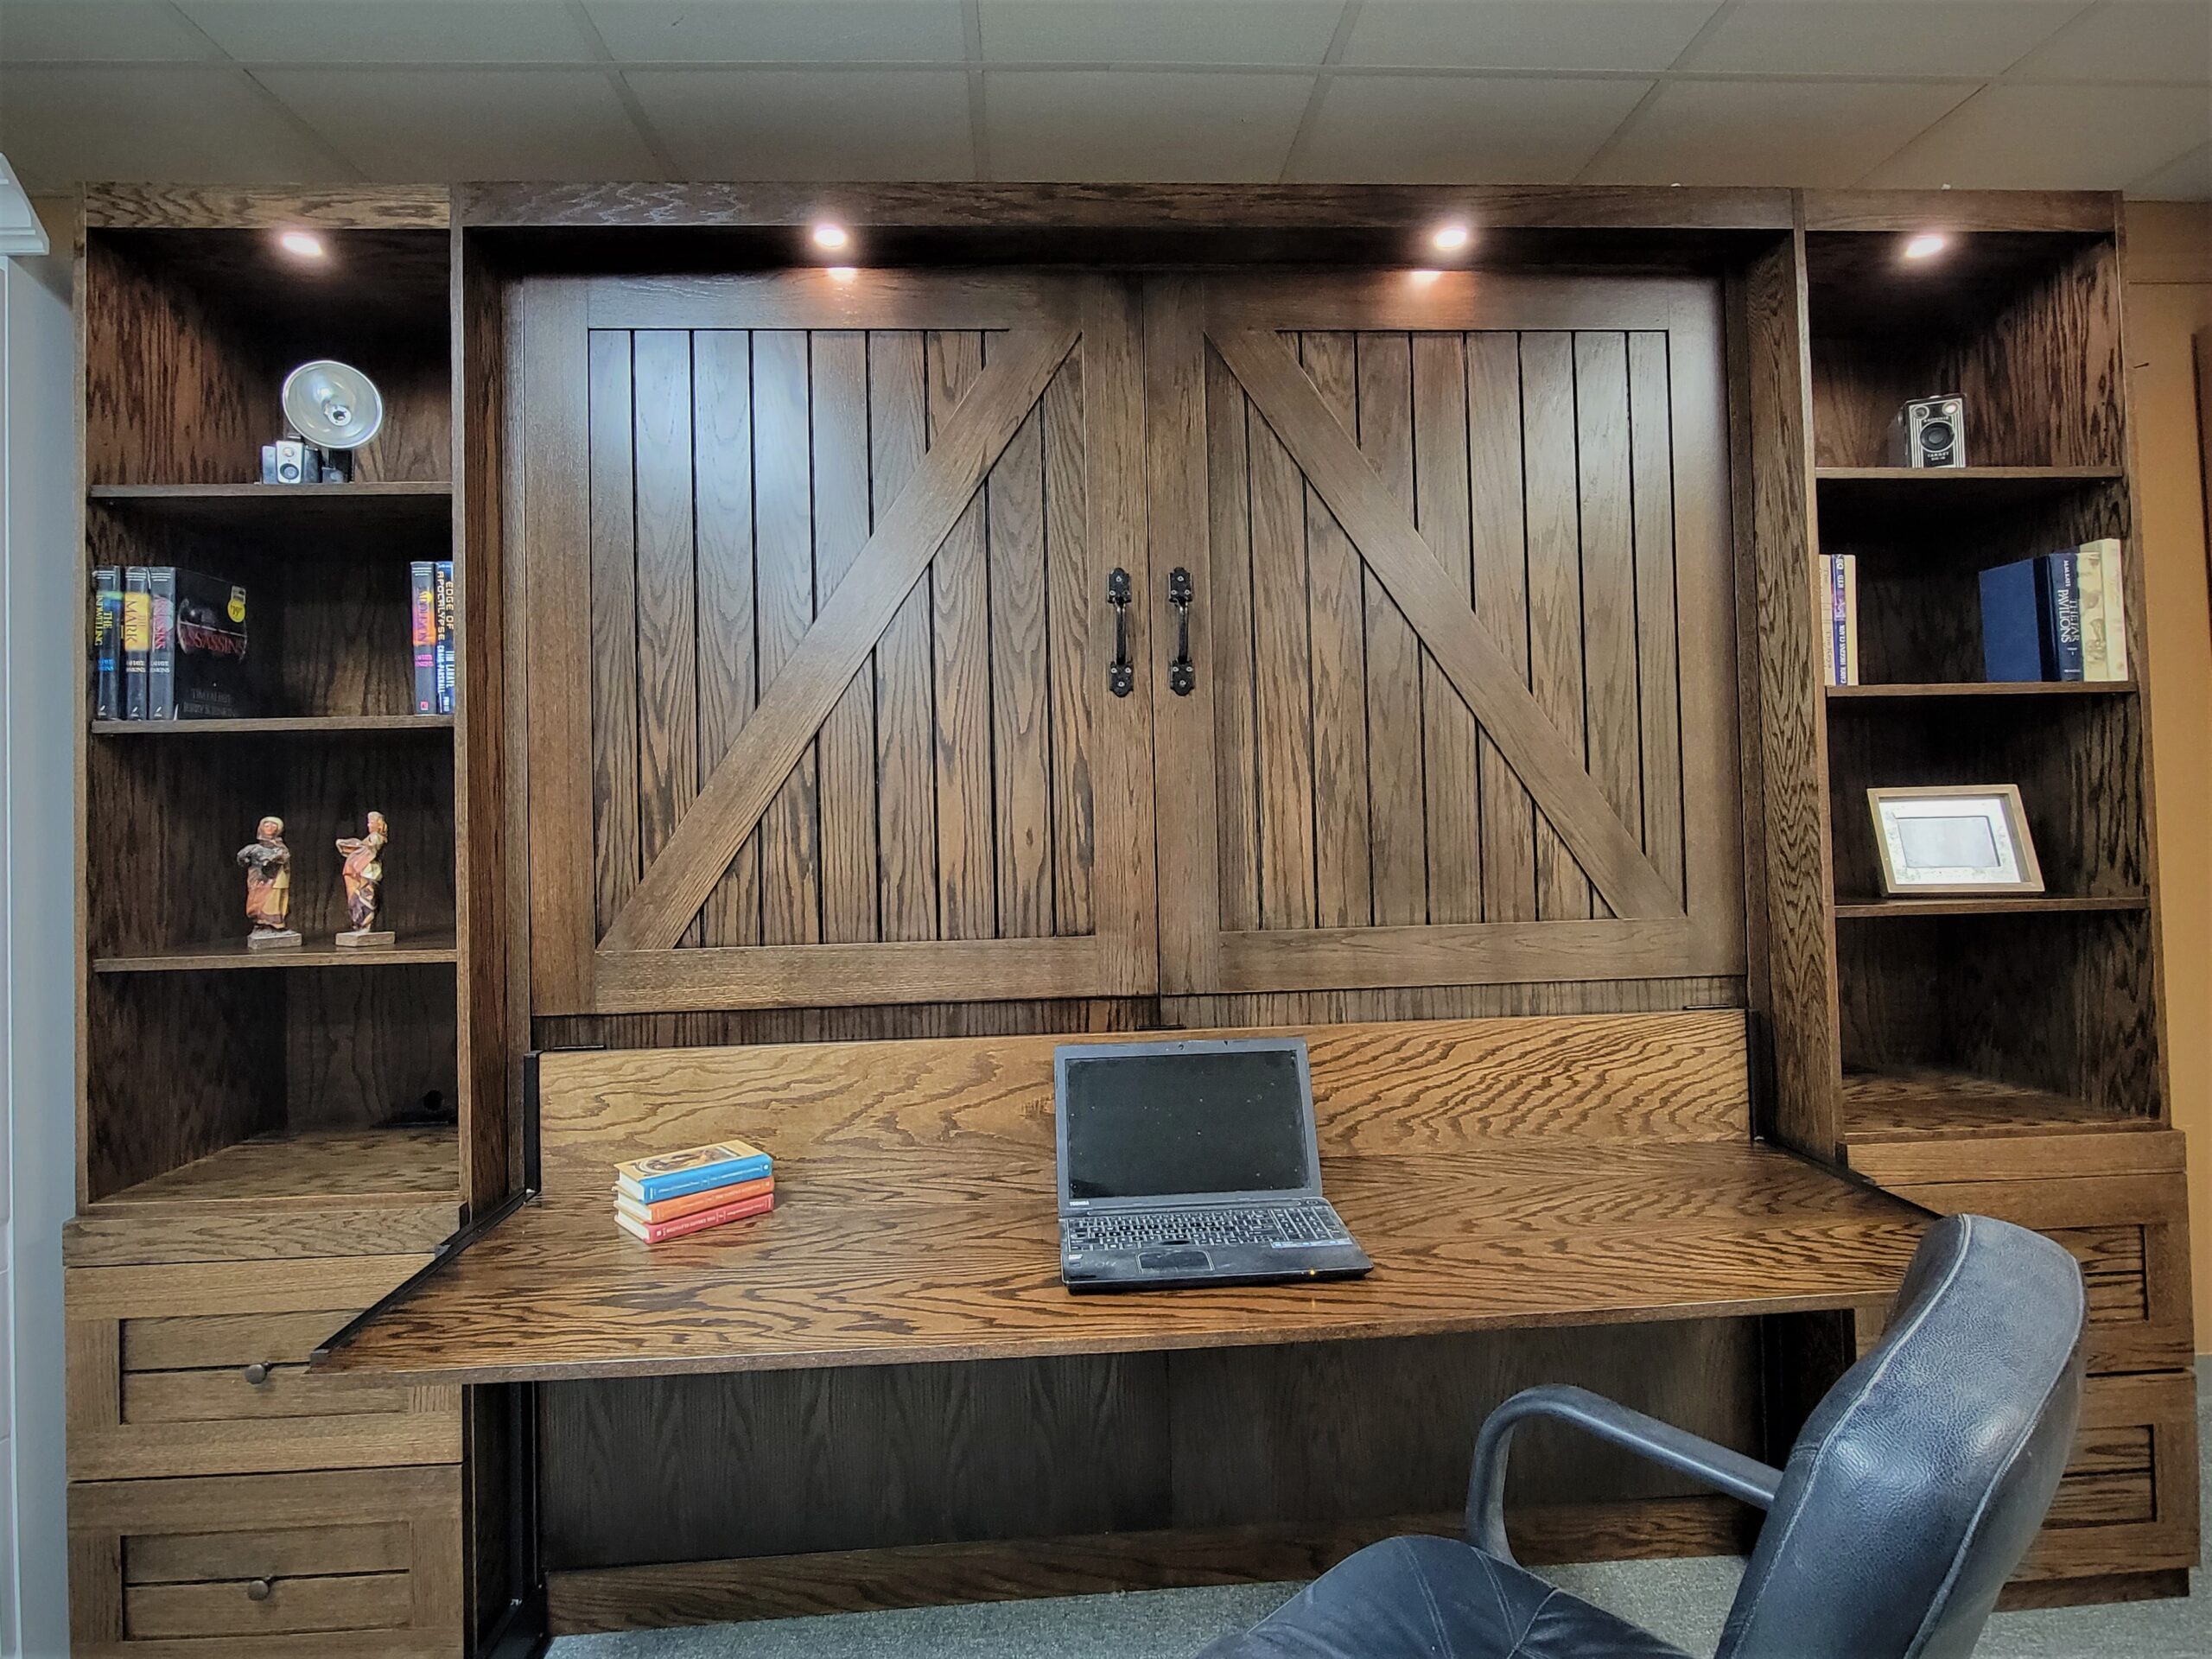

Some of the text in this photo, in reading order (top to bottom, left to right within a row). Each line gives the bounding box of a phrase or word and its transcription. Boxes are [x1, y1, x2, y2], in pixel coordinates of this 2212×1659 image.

[103, 611, 113, 629] THE
[125, 600, 137, 643] MARK
[446, 615, 454, 630] OF
[2057, 589, 2071, 643] PAVILIONS
[181, 626, 245, 654] ASSASSINS
